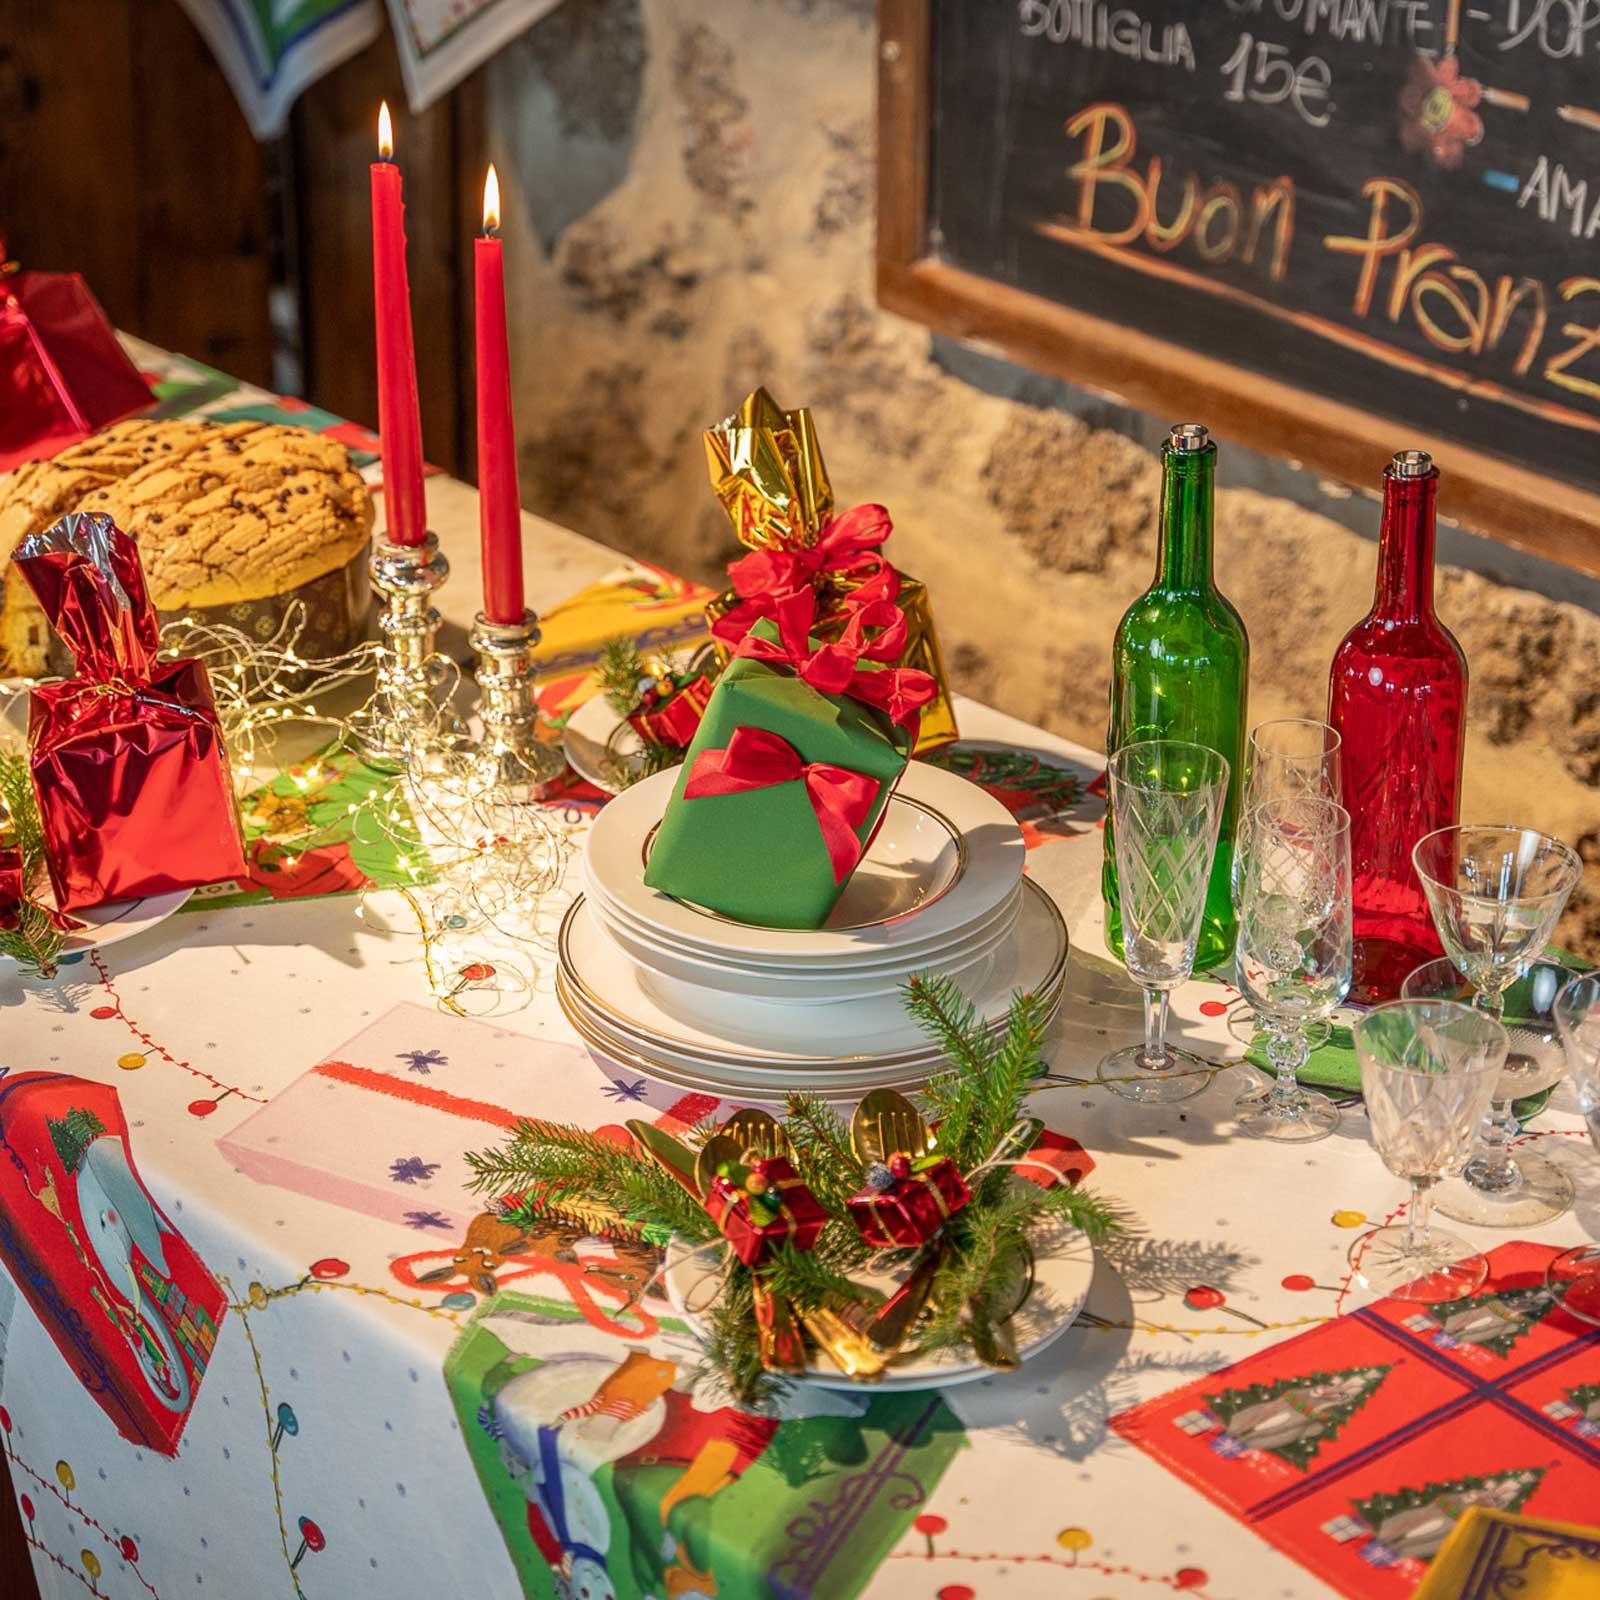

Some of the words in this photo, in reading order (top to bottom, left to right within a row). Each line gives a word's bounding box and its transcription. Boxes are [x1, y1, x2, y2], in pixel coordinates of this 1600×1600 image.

[1224, 0, 1440, 56] MANTE
[1065, 102, 1296, 282] Buon
[1322, 176, 1600, 399] Pranz
